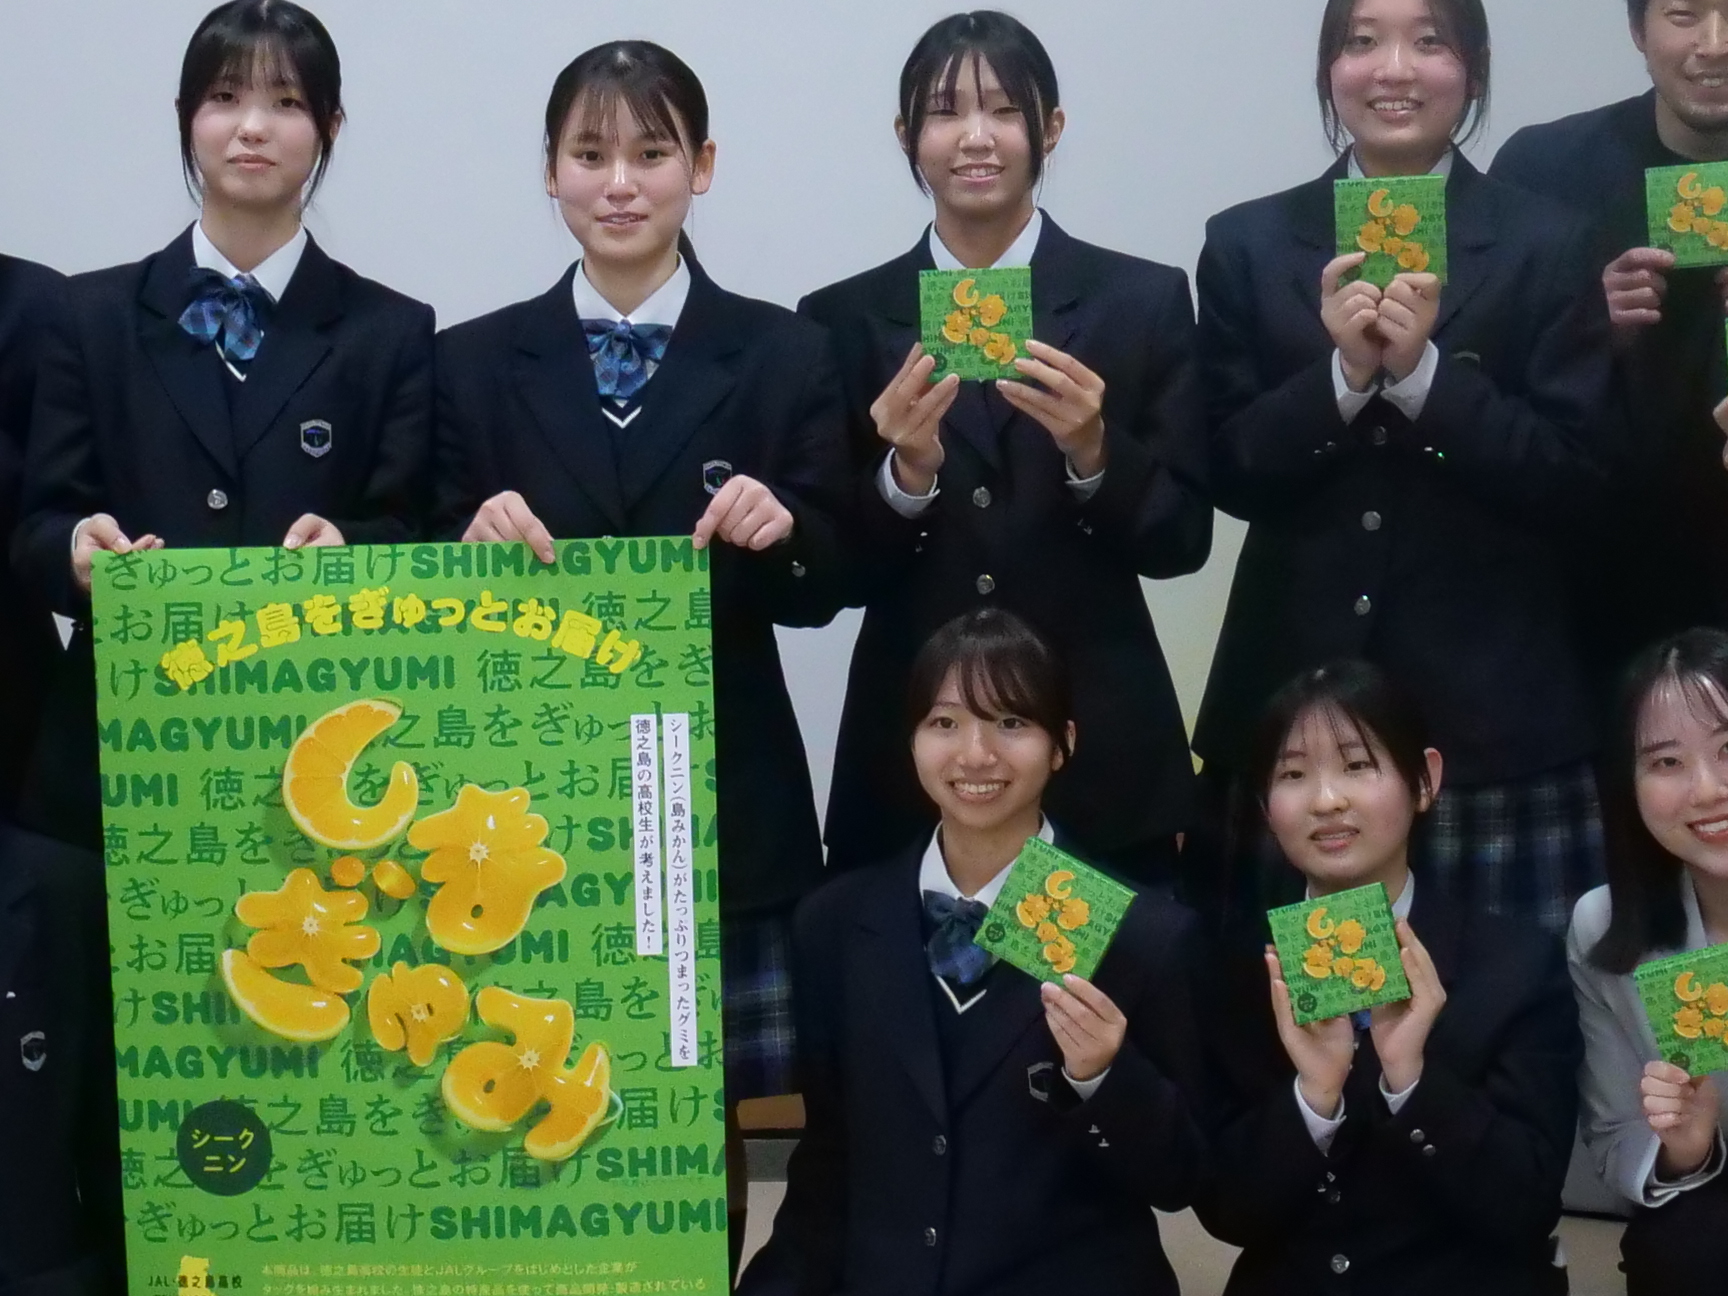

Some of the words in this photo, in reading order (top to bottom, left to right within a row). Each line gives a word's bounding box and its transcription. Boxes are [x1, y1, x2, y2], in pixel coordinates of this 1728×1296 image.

[160, 587, 641, 692] 徳之島をぎゅっとお届け
[634, 717, 657, 951] 徳之島の高校生が考えました！
[191, 1128, 256, 1151] シーク
[202, 1154, 248, 1174] ニン
